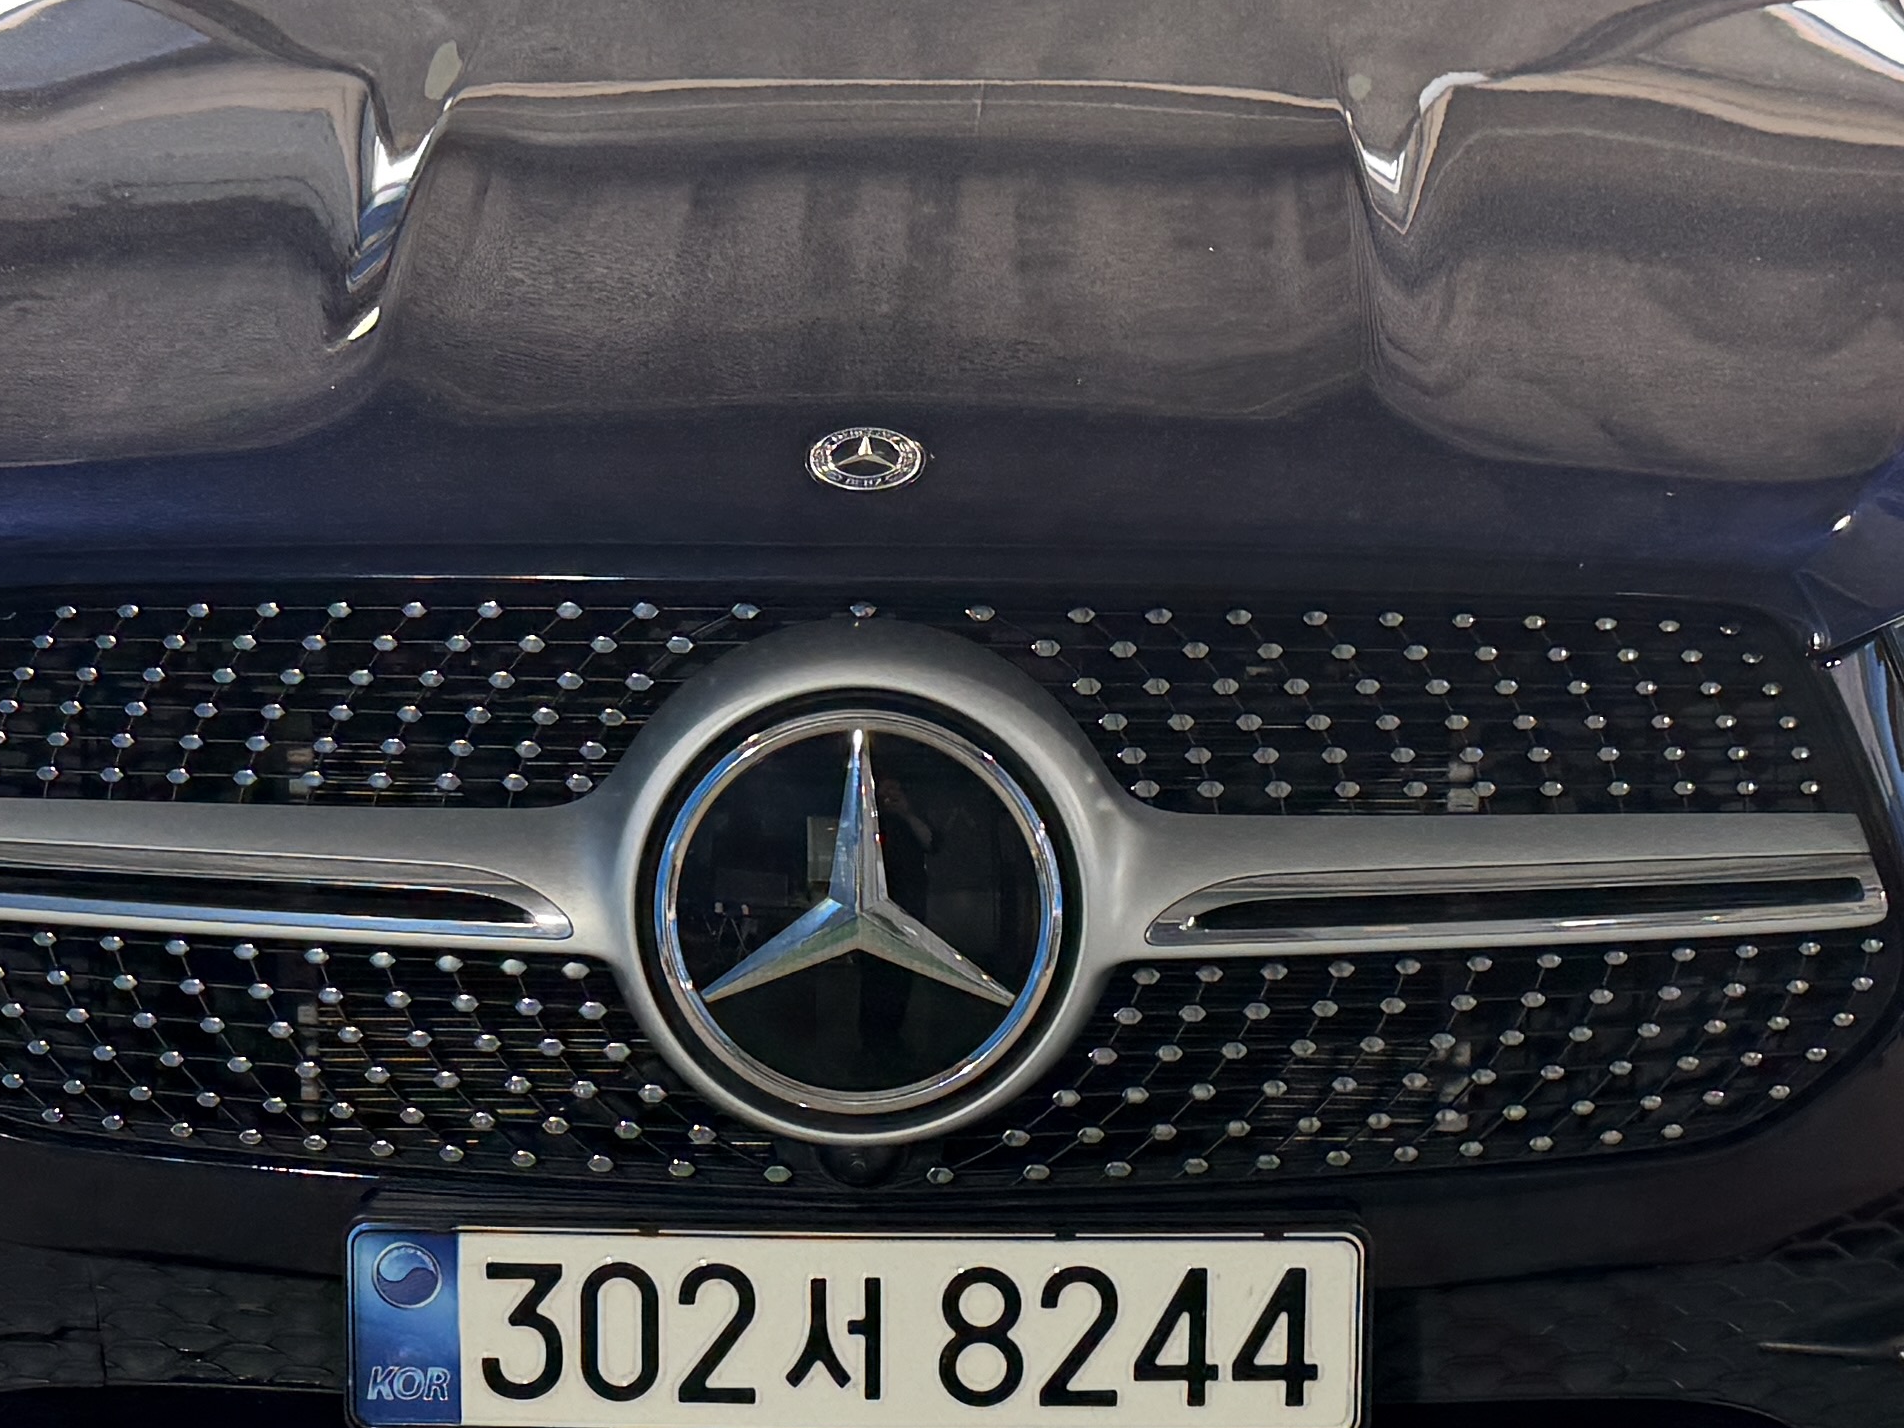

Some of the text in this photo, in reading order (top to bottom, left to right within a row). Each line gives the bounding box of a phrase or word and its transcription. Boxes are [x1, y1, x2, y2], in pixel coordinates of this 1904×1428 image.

[480, 1262, 1319, 1408] 302서 8244
[367, 1366, 450, 1401] KOR
